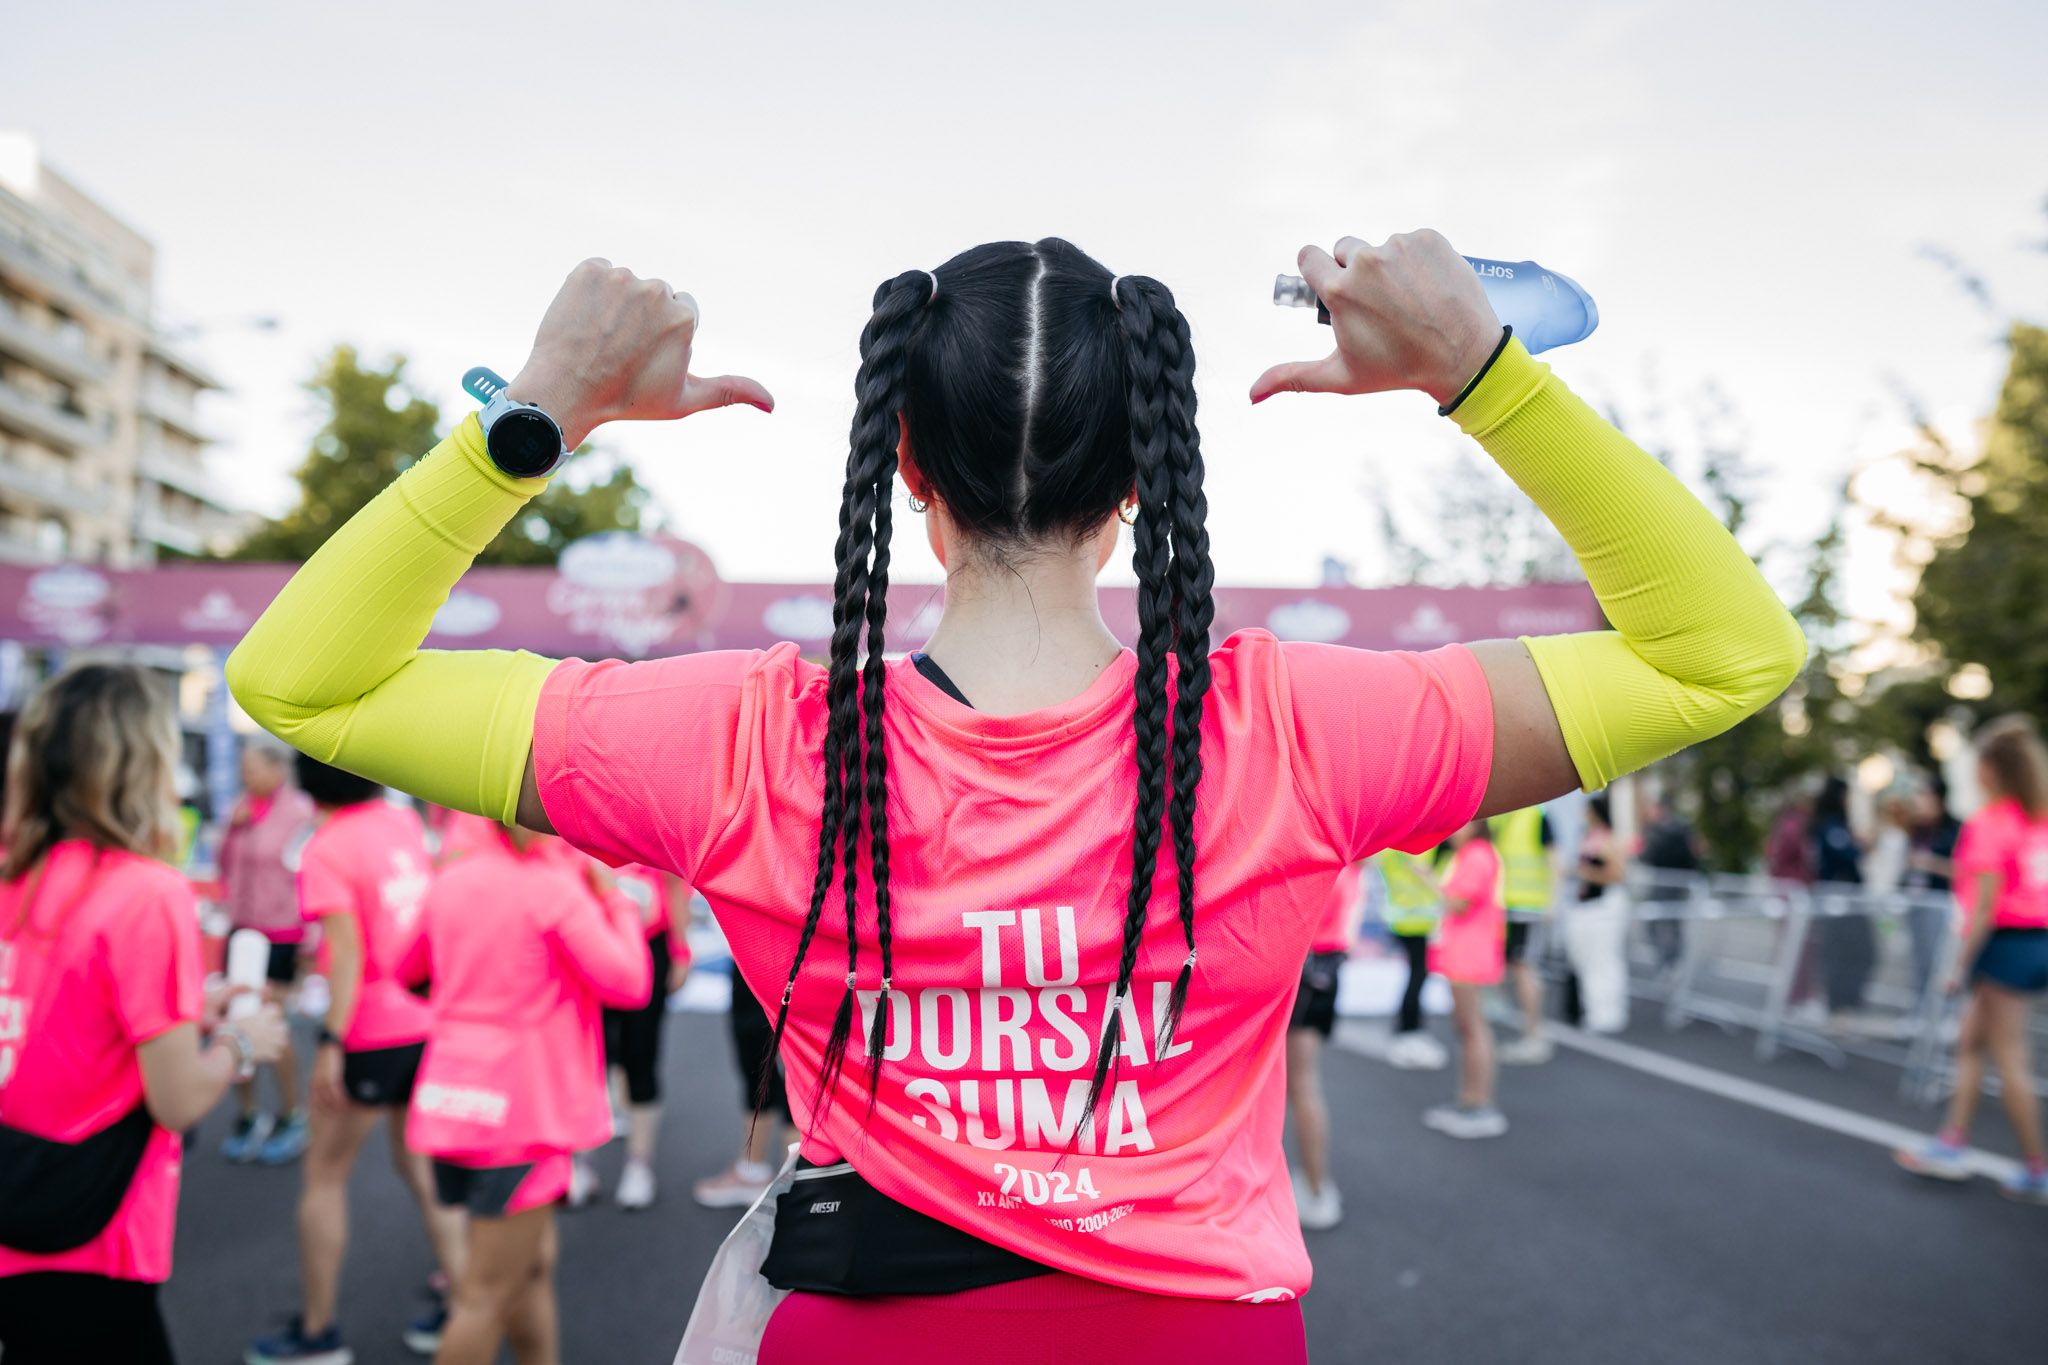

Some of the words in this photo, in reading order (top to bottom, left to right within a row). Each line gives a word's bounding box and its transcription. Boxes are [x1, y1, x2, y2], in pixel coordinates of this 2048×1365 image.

[1478, 263, 1514, 280] SOFT
[962, 906, 1079, 987] TU
[856, 981, 1194, 1072] DORSAL
[904, 1079, 1156, 1155] SUMA
[977, 1191, 996, 1207] XX
[1076, 1203, 1135, 1233] 2004-2024
[993, 1162, 1102, 1206] 2024
